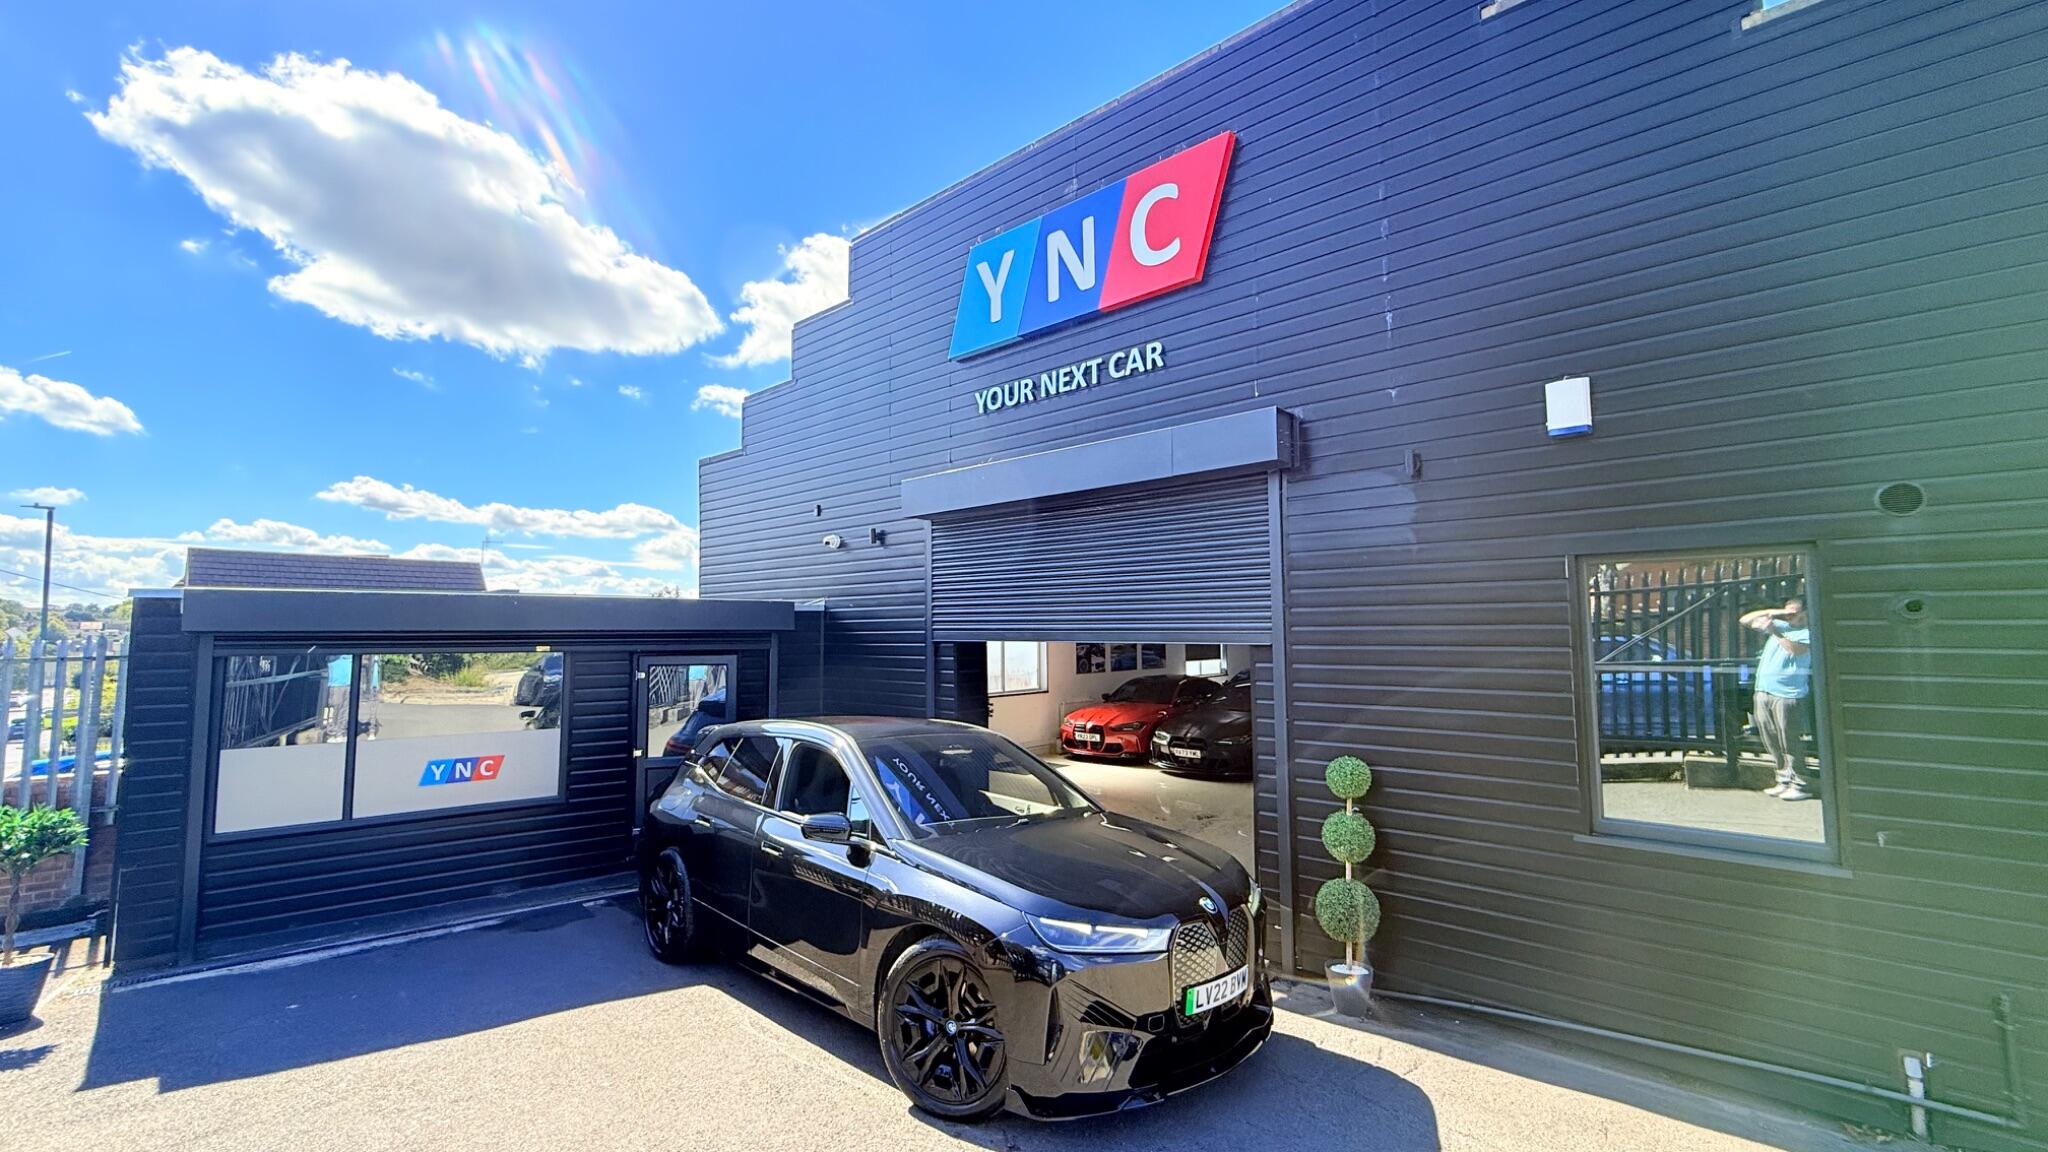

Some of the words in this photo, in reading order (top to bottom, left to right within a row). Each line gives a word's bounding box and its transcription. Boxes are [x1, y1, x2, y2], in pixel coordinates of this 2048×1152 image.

[976, 183, 1181, 323] YNC
[975, 378, 1034, 414] YOUR
[1040, 358, 1102, 398] NEXT
[1108, 341, 1165, 379] CAR
[431, 759, 495, 781] YNC
[1196, 980, 1228, 1008] LV22
